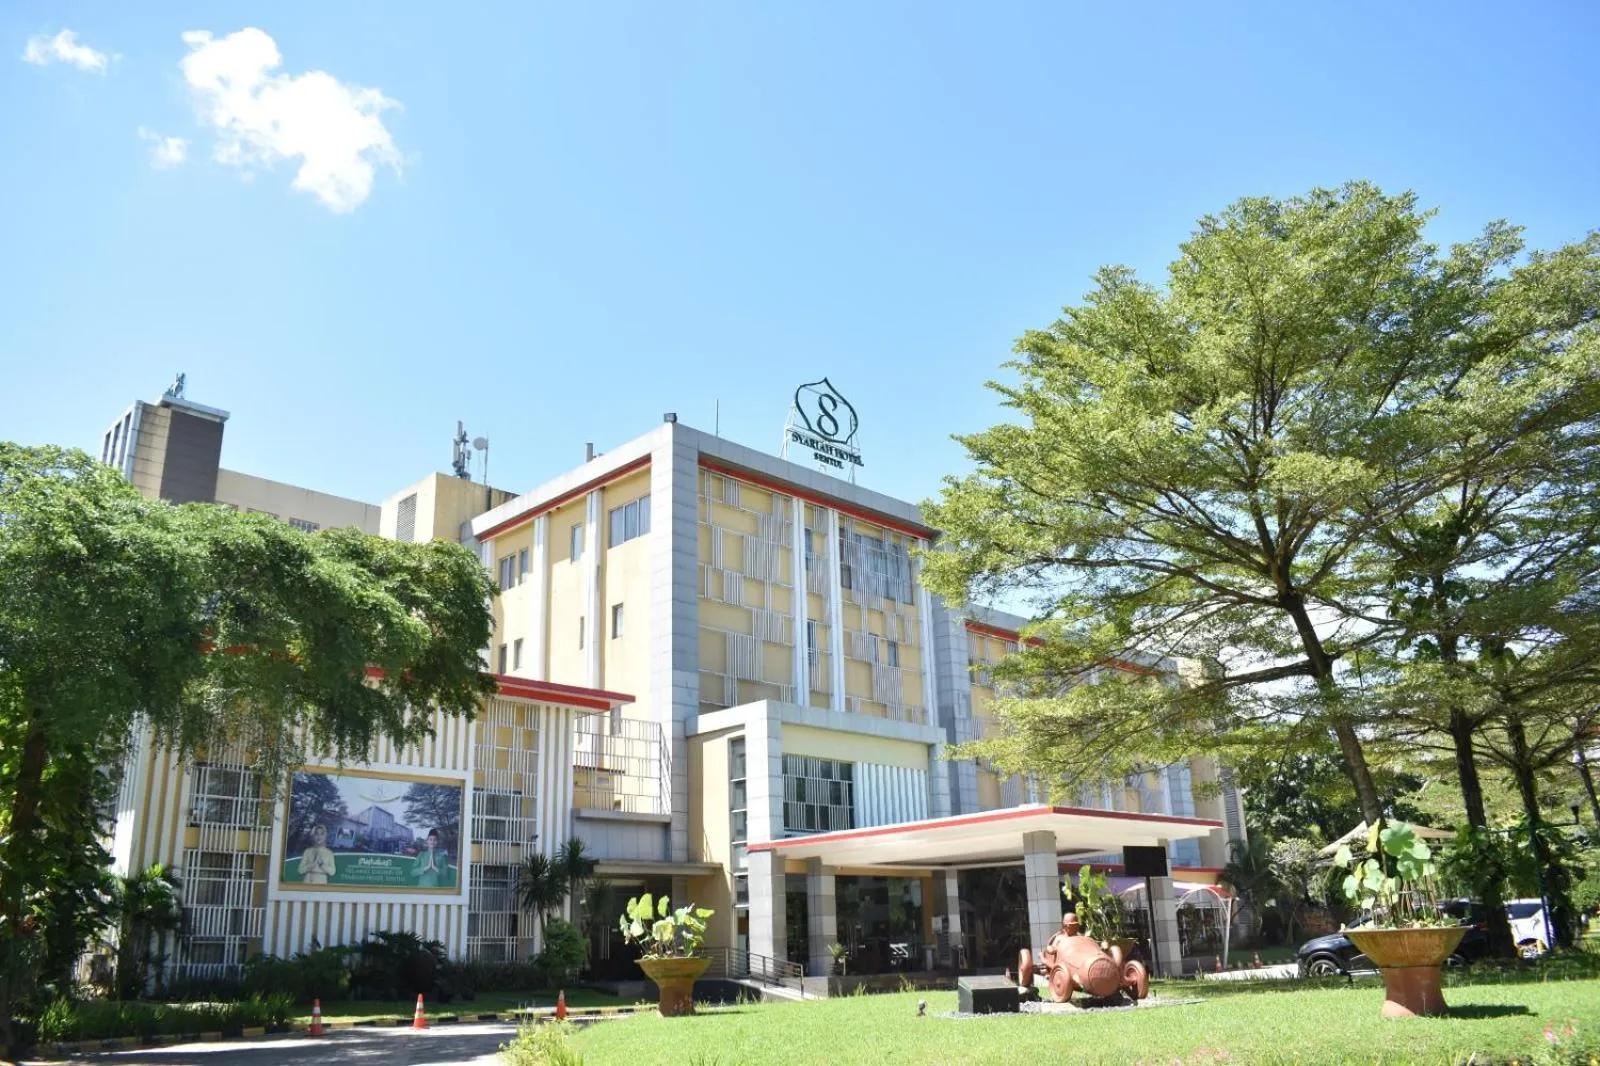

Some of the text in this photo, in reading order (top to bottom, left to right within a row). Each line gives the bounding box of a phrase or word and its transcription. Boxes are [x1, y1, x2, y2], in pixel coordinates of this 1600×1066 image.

[792, 432, 864, 467] SYARIAH HOTEL
[814, 452, 844, 469] SENTUL
